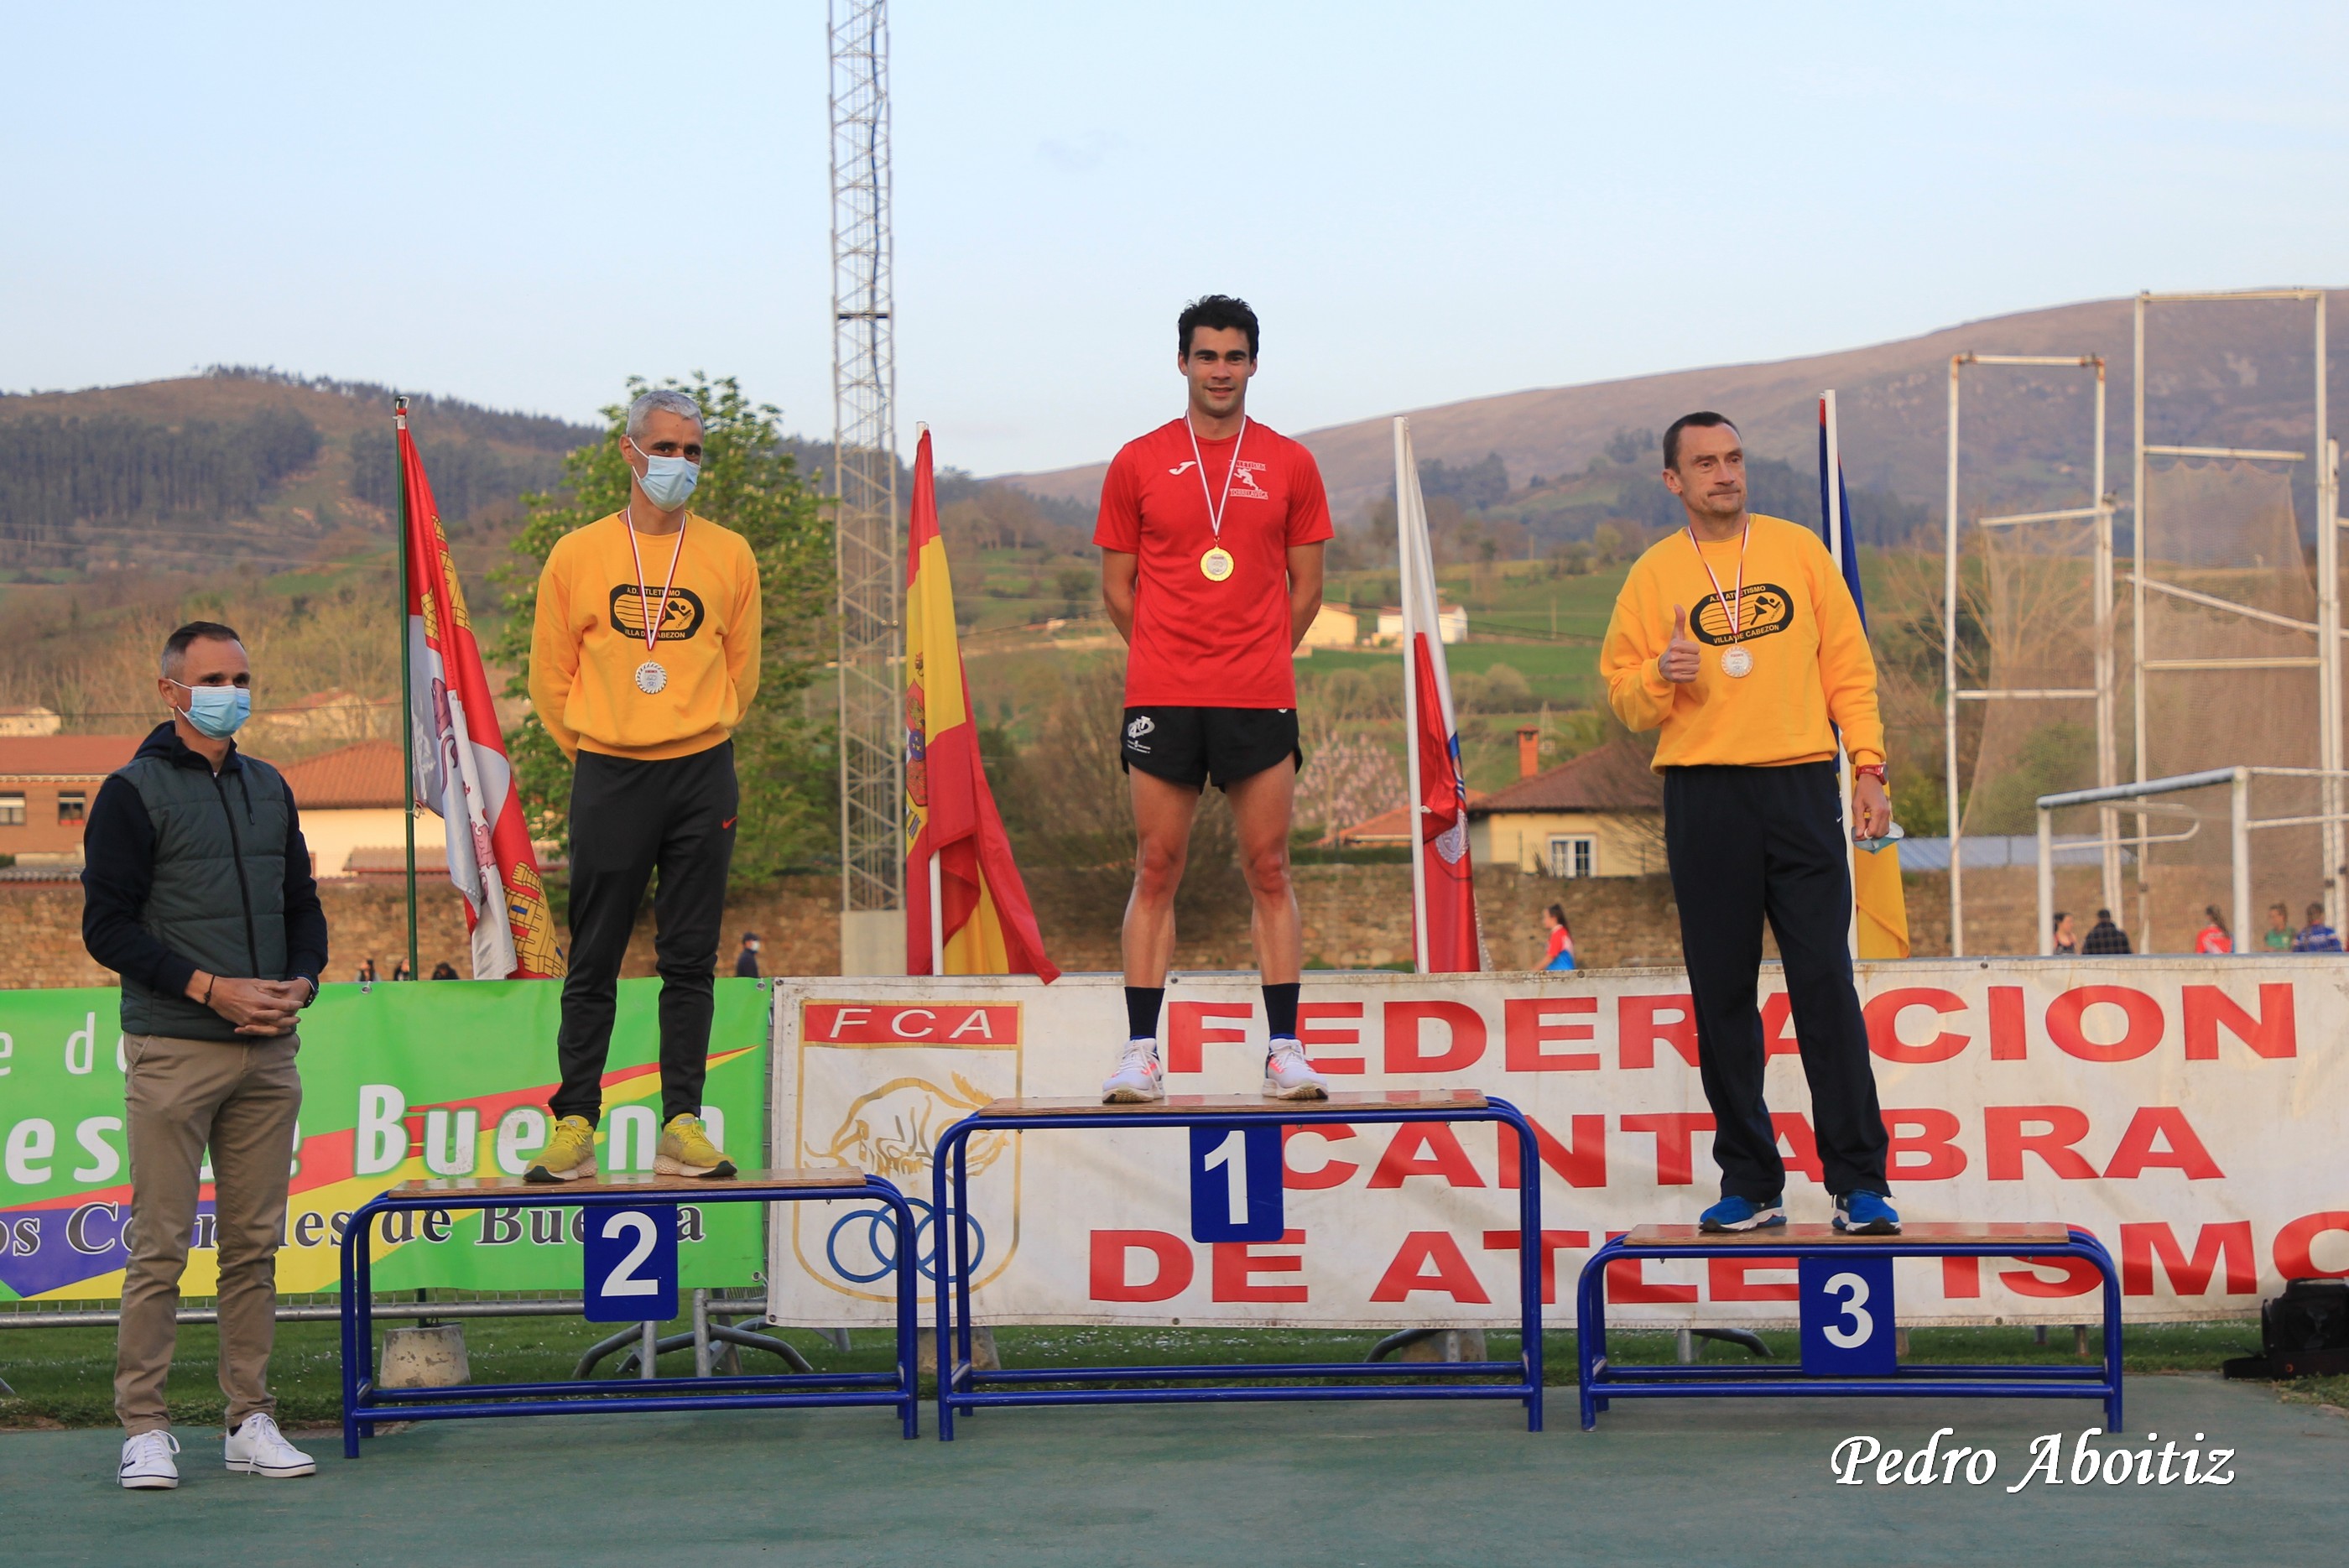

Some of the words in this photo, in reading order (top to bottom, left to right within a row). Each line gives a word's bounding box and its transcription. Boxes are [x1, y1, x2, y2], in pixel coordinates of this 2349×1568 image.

[1713, 634, 1733, 644] VILLA
[1745, 624, 1779, 638] CABEZON
[829, 1008, 992, 1039] FCA
[1204, 1129, 1249, 1225] 1
[1282, 1105, 2225, 1190] CANTABRA
[601, 1211, 659, 1297] 2
[1090, 1228, 1309, 1303] DE
[1822, 1272, 1874, 1349] 3
